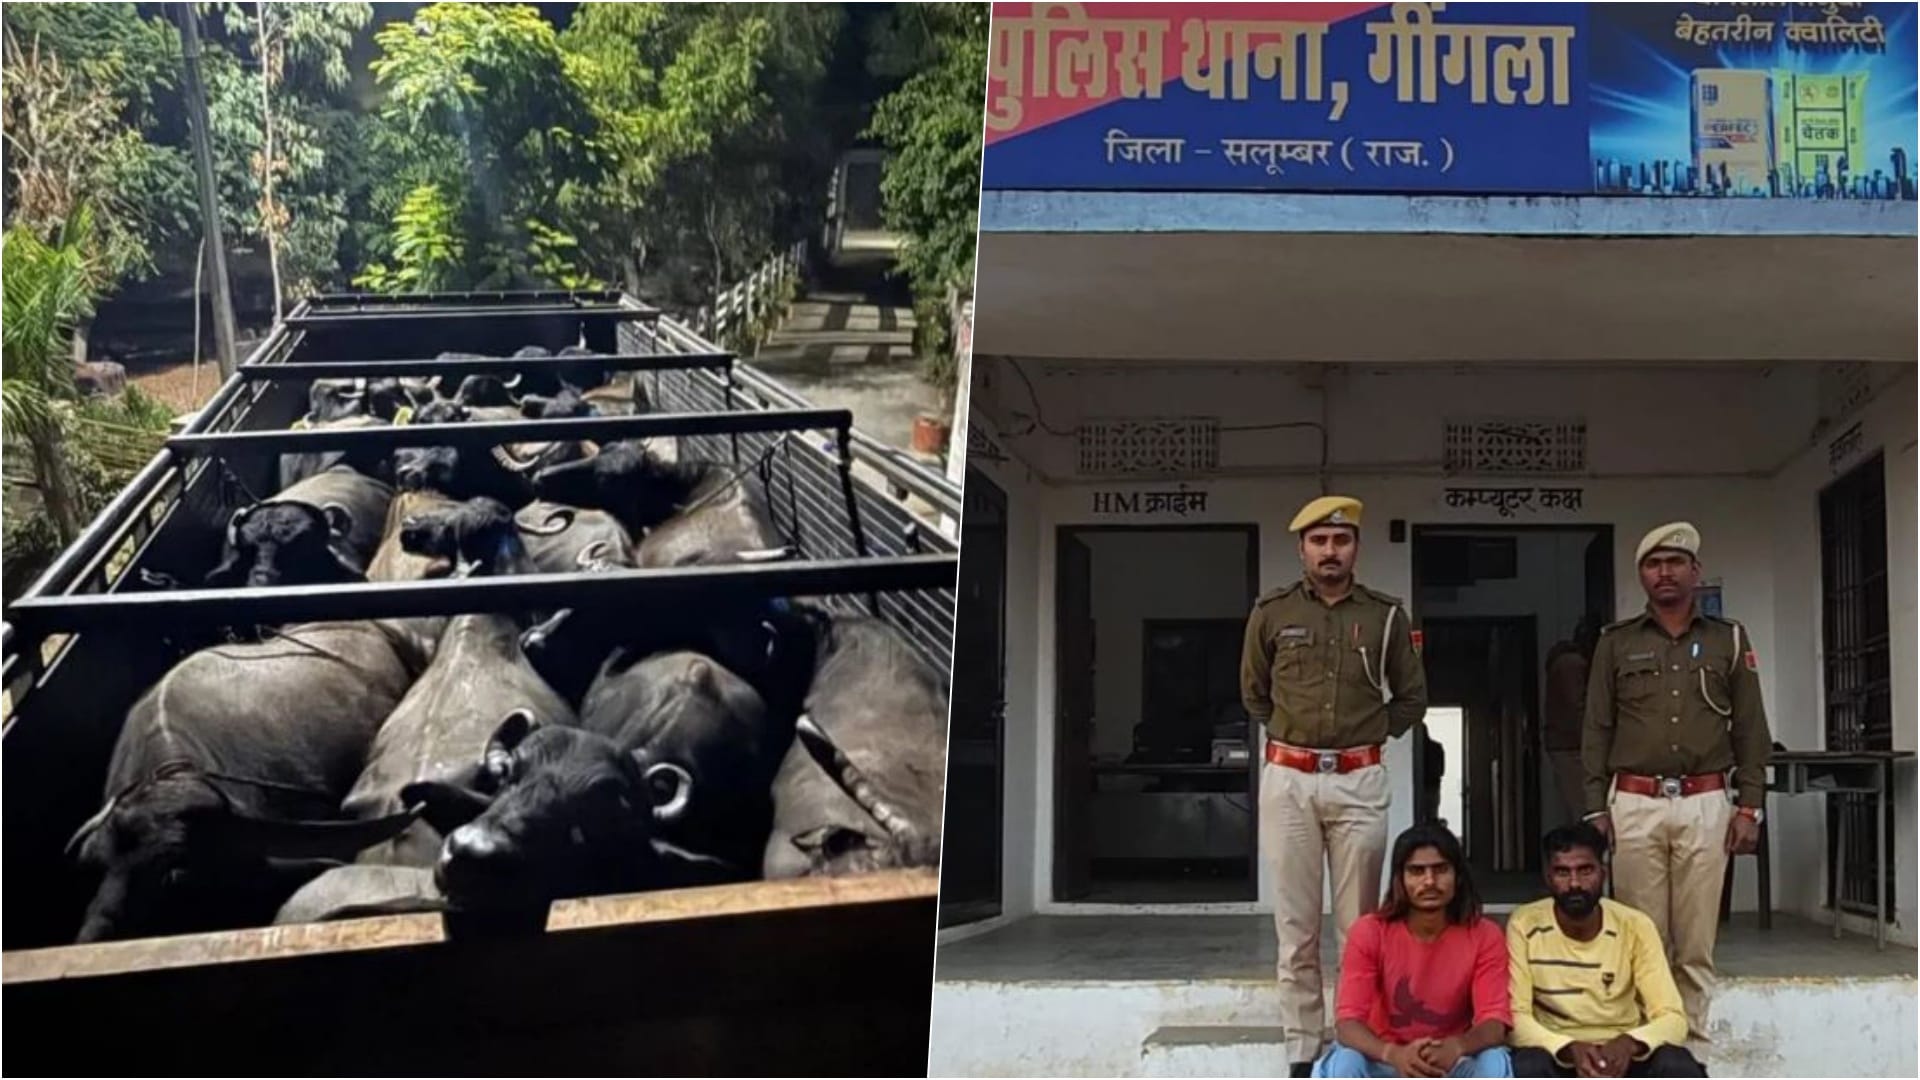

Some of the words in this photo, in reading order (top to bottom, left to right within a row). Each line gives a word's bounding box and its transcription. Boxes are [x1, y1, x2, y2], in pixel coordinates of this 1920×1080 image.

[1675, 12, 1774, 45] बेहतरीन
[1783, 14, 1885, 44] क्वालिटी
[987, 2, 1170, 130] पुलिस
[1182, 18, 1349, 121] थाना,
[1366, 2, 1575, 105] गींगला
[1104, 129, 1186, 163] जिला
[1221, 138, 1334, 175] सलूम्बर
[1093, 491, 1140, 513] HM
[1144, 483, 1208, 516] क्राईम
[1444, 487, 1536, 518] कम्प्यूटर
[1538, 488, 1584, 512] कक्ष
